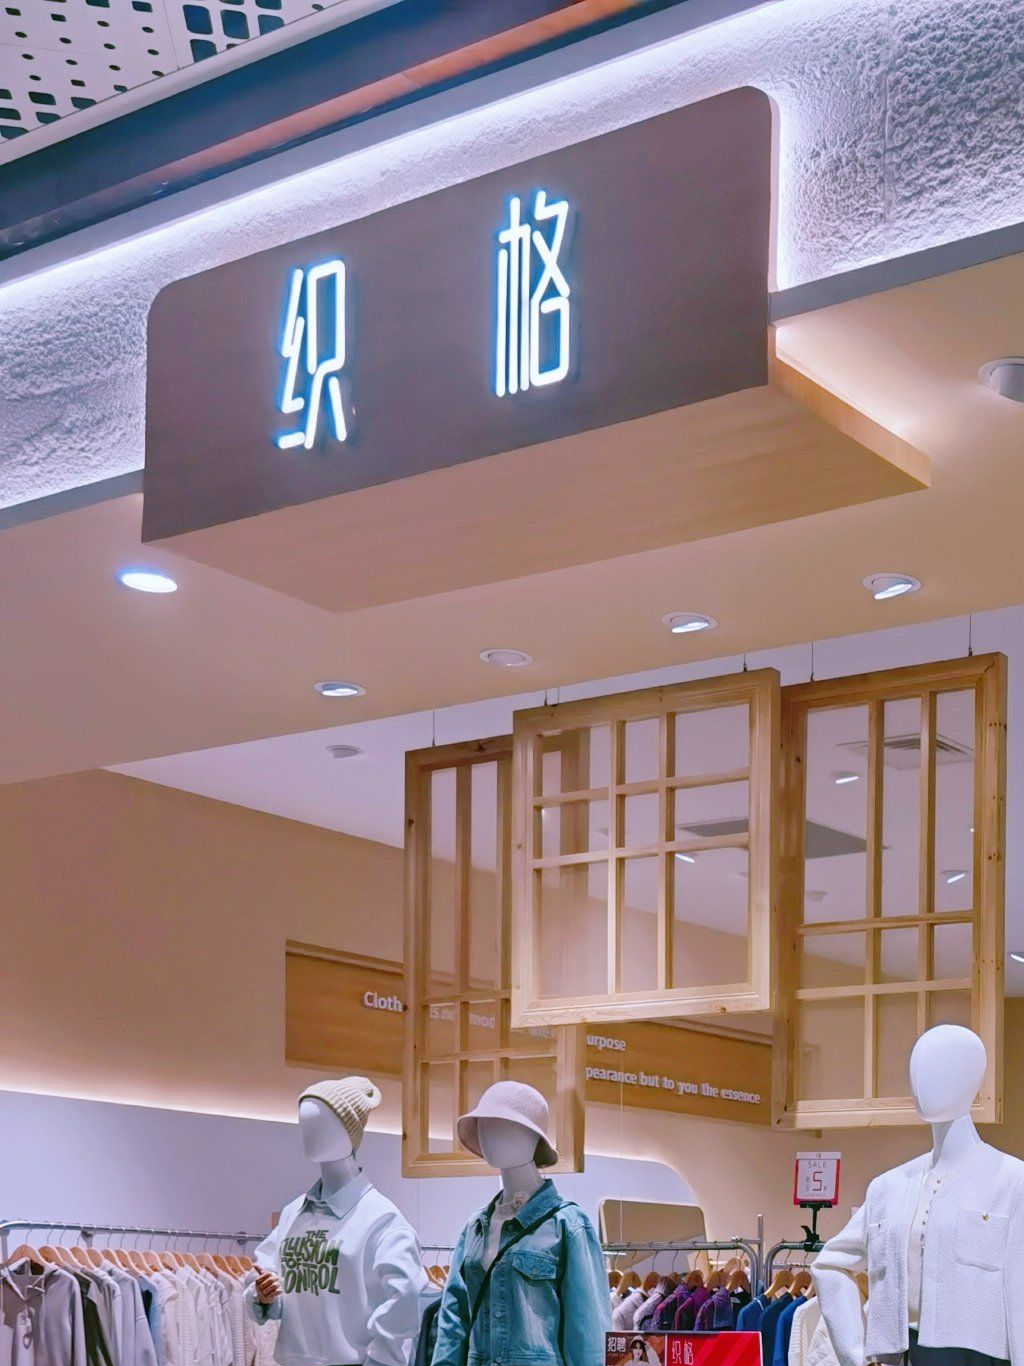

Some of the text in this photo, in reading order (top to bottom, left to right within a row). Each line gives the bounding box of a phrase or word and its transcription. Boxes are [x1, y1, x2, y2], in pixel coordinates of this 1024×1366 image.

[364, 991, 402, 1012] Cloth
[586, 1034, 627, 1051] urpose
[585, 1066, 761, 1104] pearance but to you the essence
[813, 1171, 823, 1191] 5
[306, 1229, 329, 1239] THE
[286, 1257, 302, 1269] OF
[607, 1336, 626, 1352] 招聘
